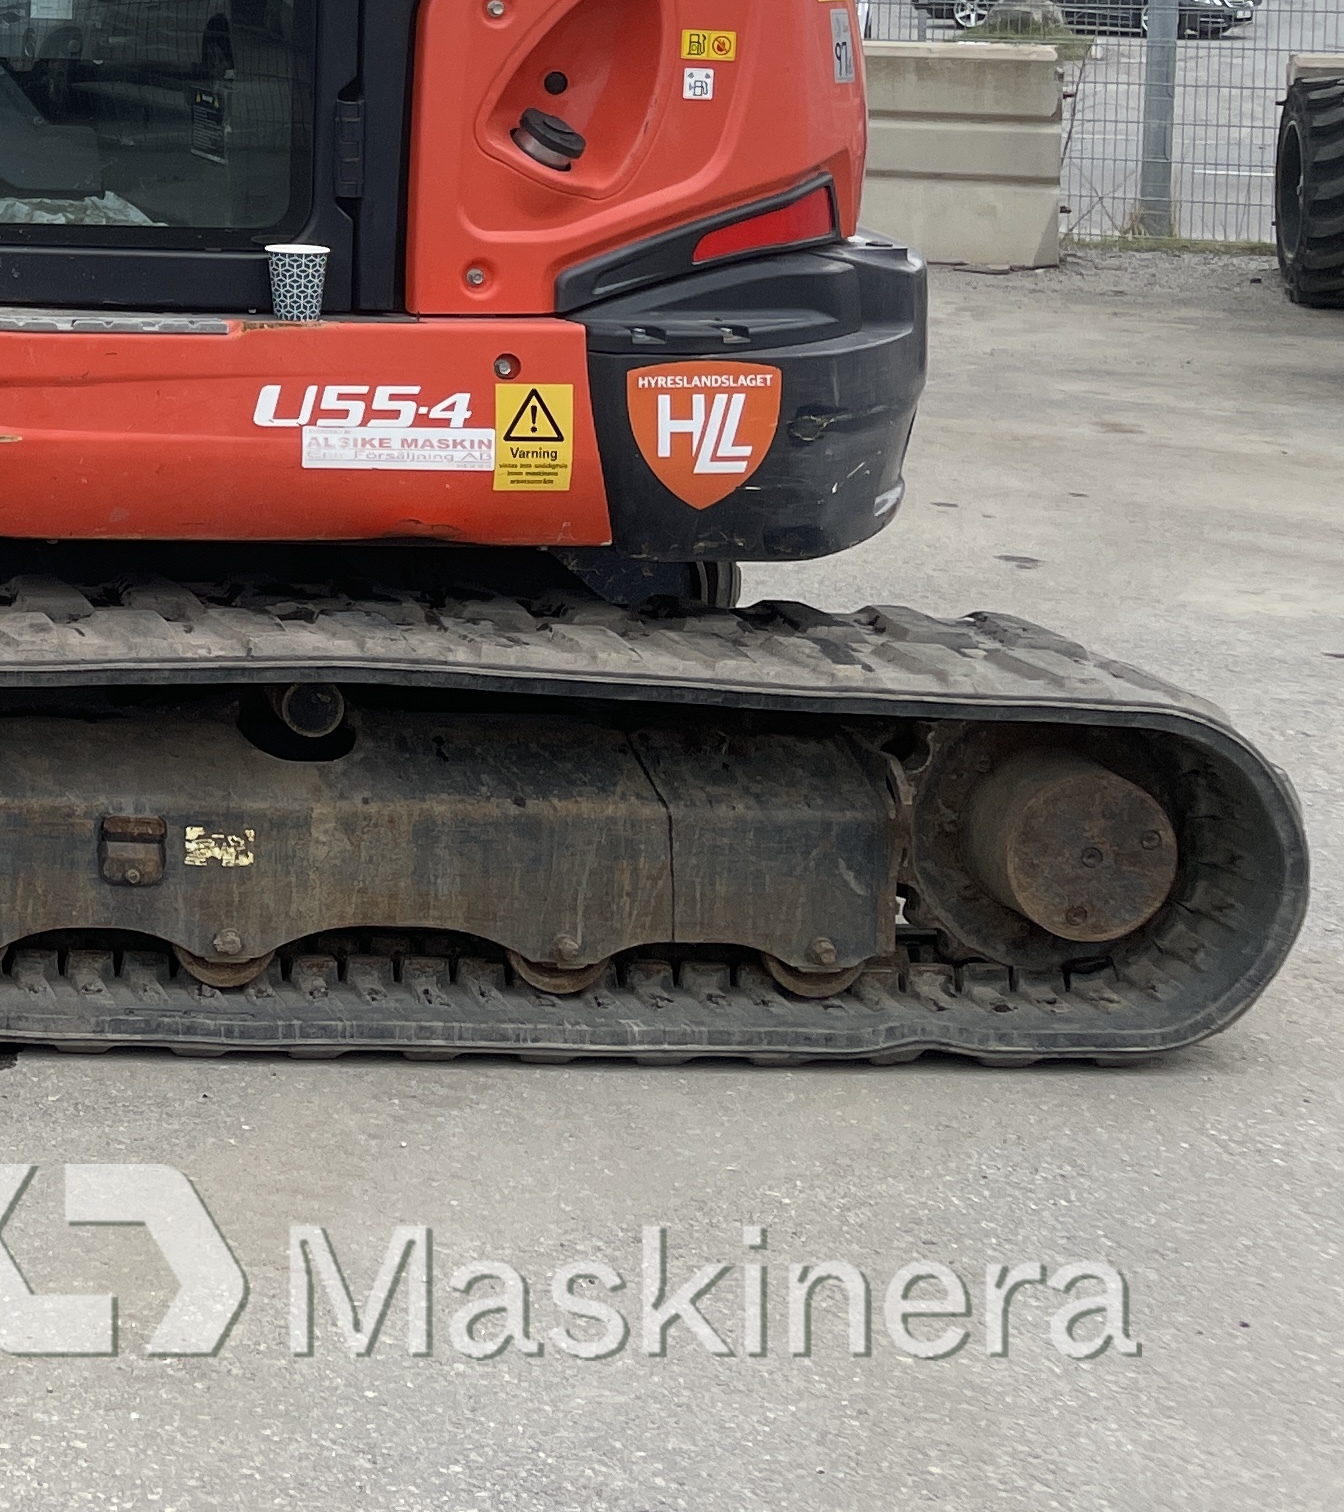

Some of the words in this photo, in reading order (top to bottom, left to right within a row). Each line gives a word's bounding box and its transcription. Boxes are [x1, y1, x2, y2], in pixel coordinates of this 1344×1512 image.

[638, 374, 773, 388] HYRESLANDSLAGET
[658, 393, 752, 473] HLL
[401, 437, 493, 450] MASKIN
[510, 447, 558, 462] Varning
